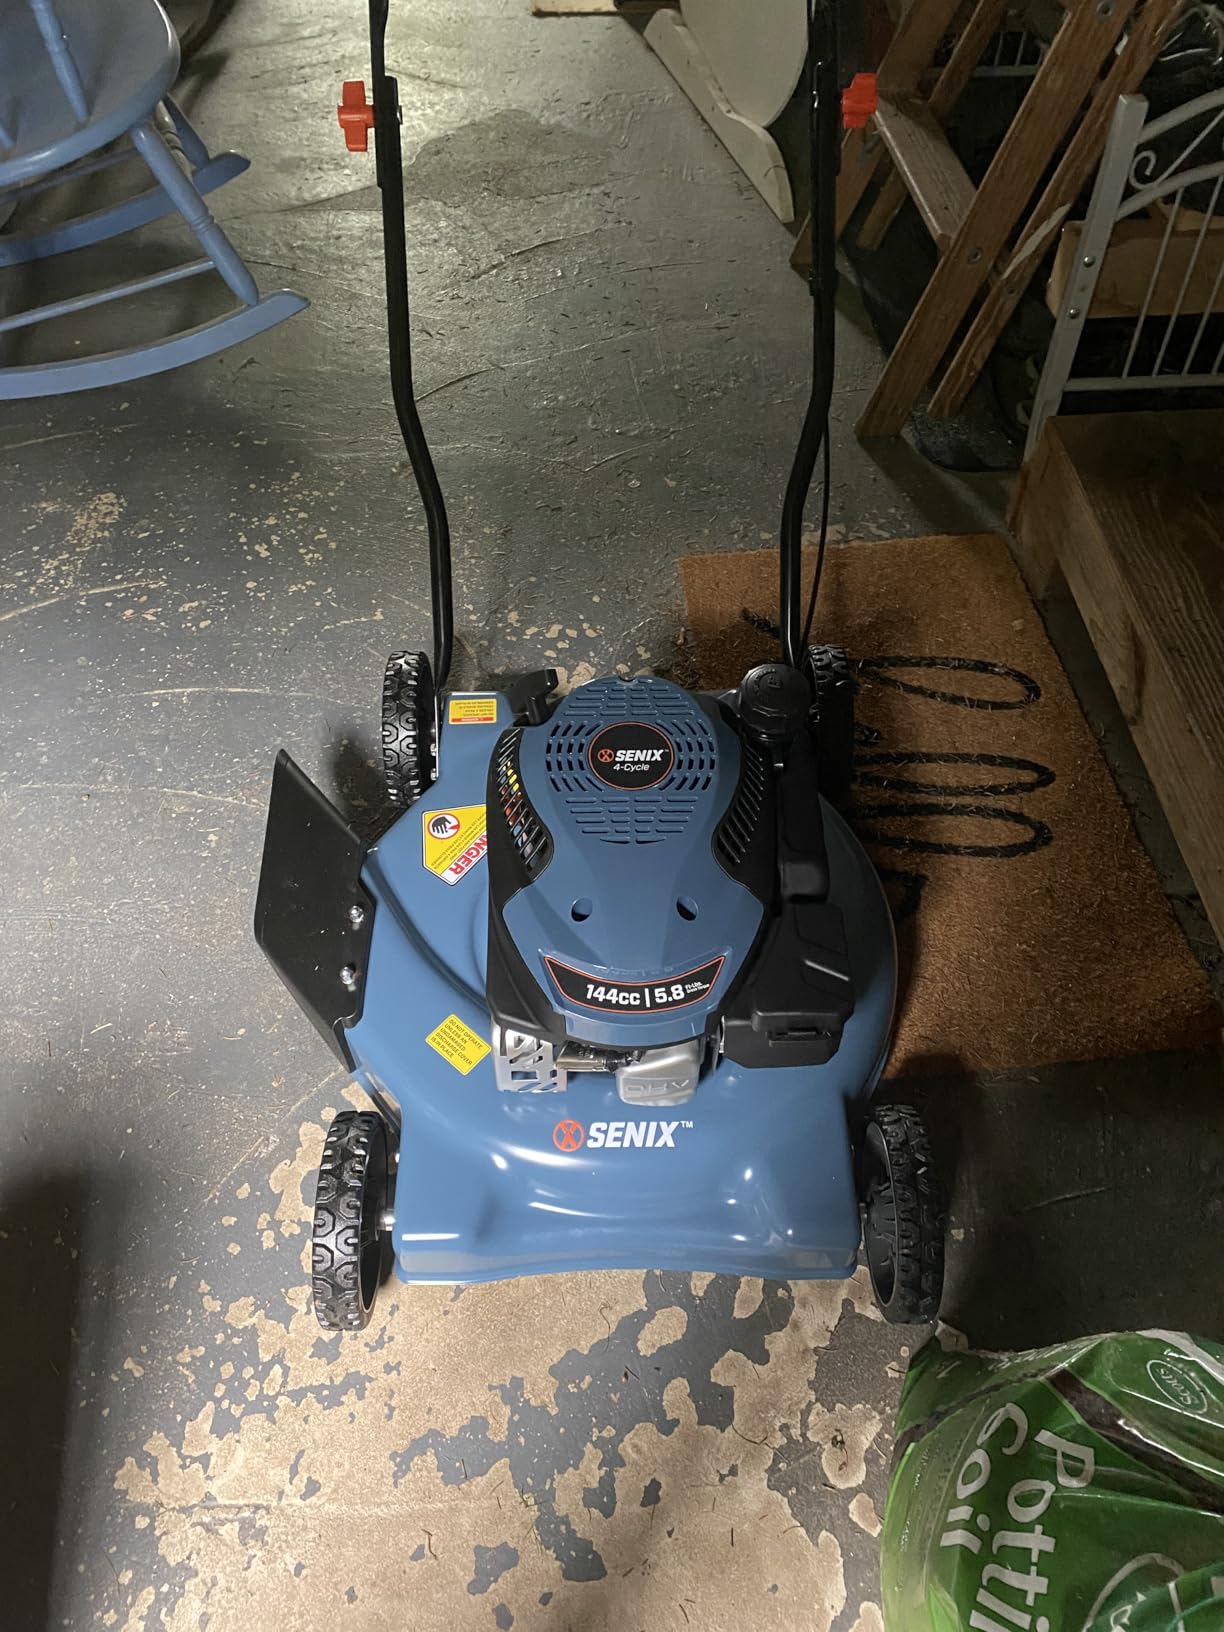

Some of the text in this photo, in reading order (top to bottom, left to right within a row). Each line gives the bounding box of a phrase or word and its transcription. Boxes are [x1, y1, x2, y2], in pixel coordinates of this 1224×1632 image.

[613, 763, 650, 773] 4-Cycle
[586, 984, 641, 1006] 144cc
[654, 984, 685, 1003] 5.8
[463, 1031, 483, 1049] OPERATE
[939, 1402, 1028, 1555] Soil
